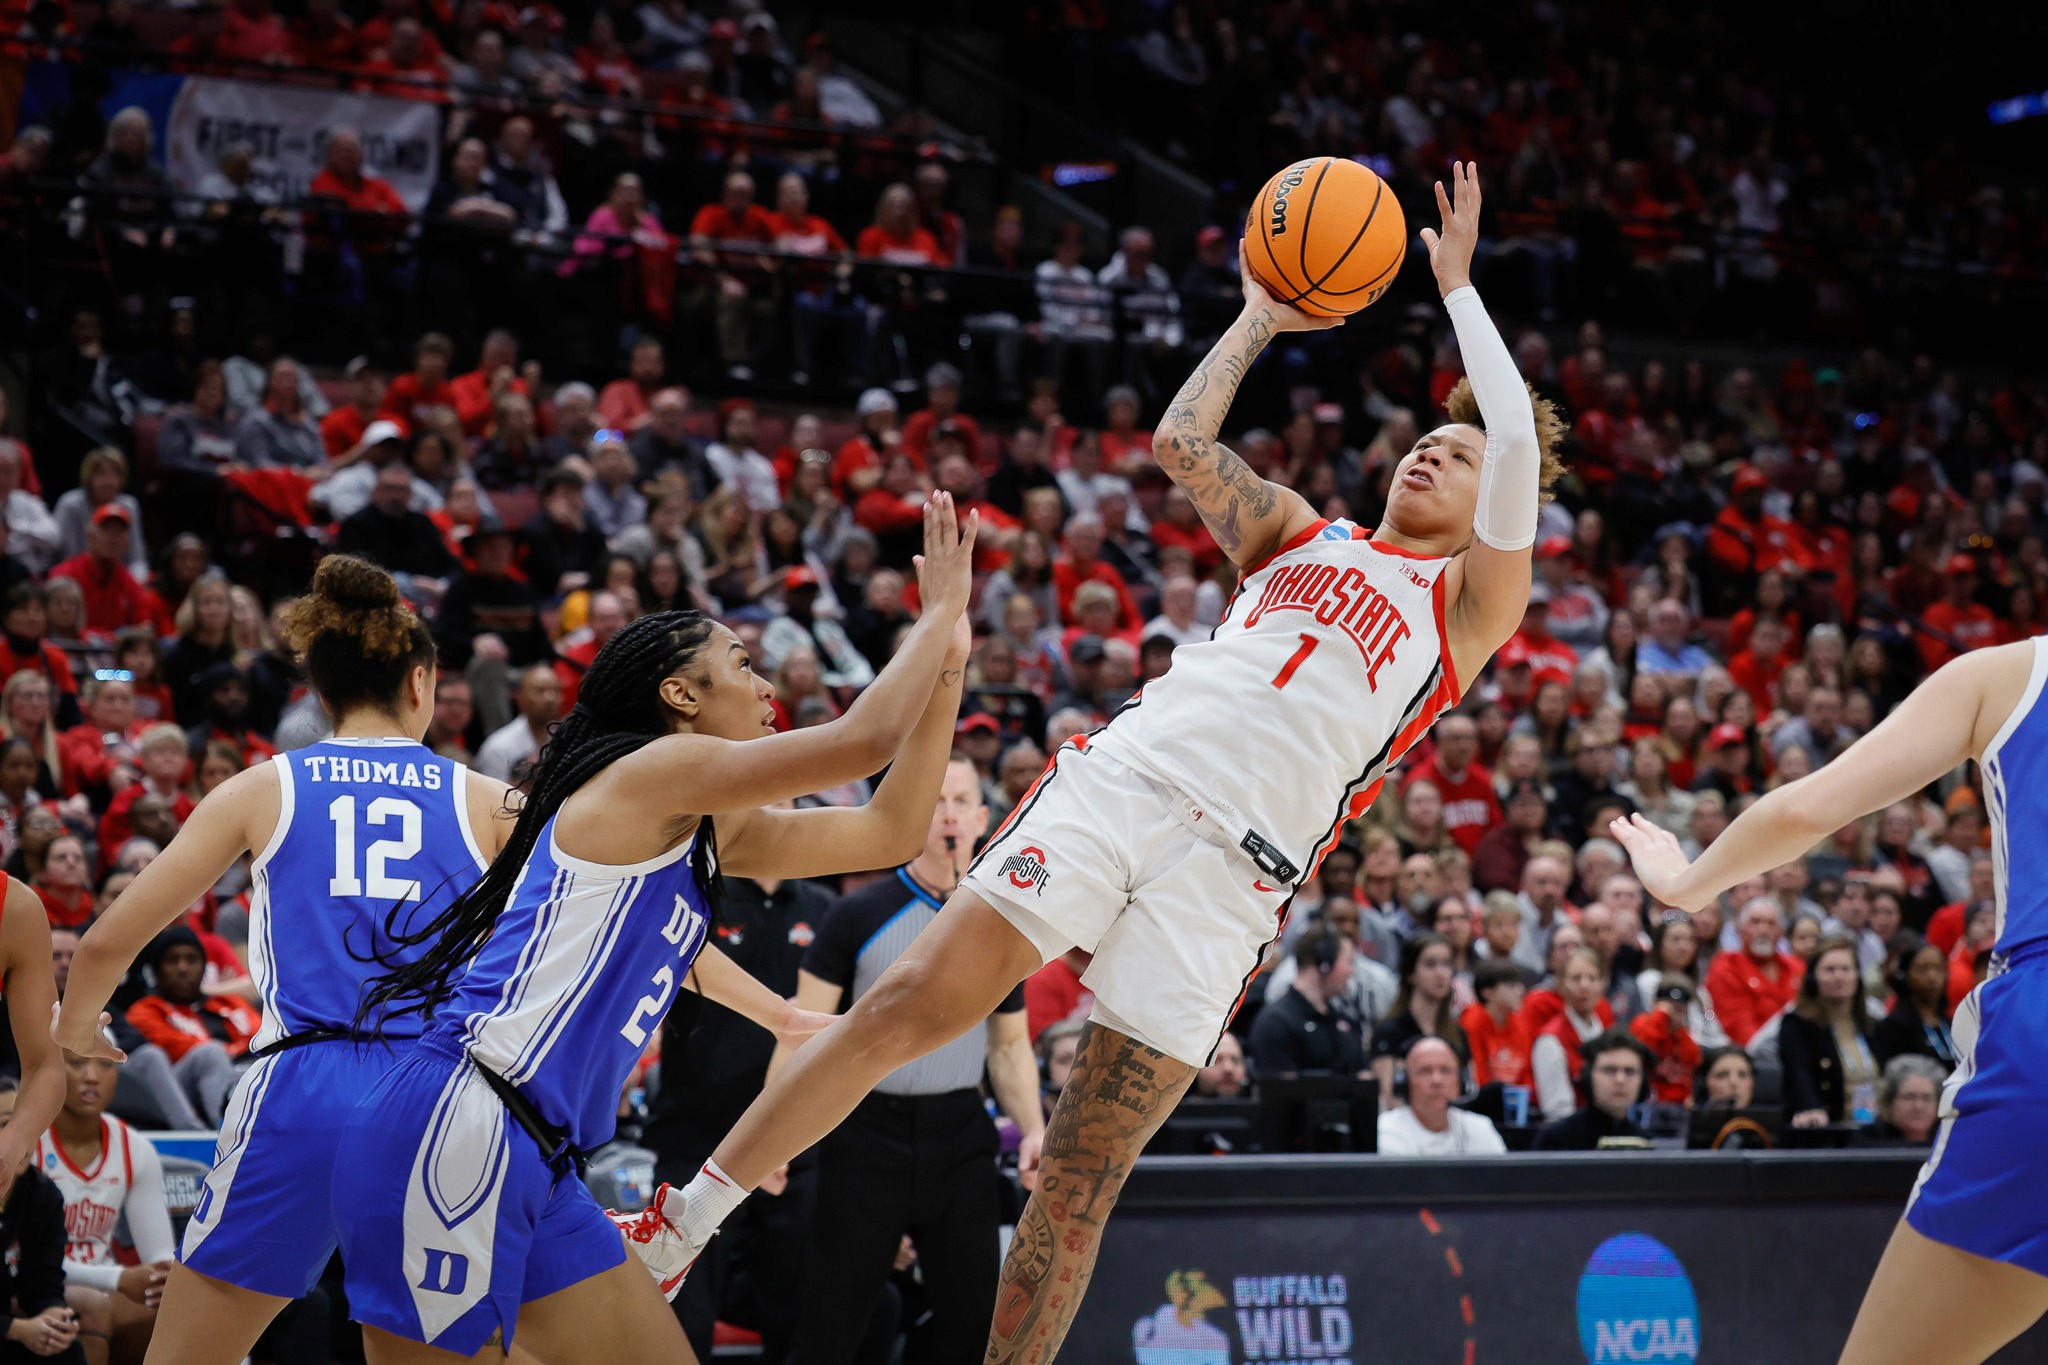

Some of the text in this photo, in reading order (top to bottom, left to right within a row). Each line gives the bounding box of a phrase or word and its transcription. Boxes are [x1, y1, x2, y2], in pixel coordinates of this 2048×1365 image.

[1270, 633, 1320, 692] 1
[304, 756, 442, 791] THOMAS
[329, 794, 423, 902] 12
[416, 1246, 469, 1296] D
[1235, 1306, 1353, 1359] WILD
[1593, 1317, 1698, 1362] NCAA
